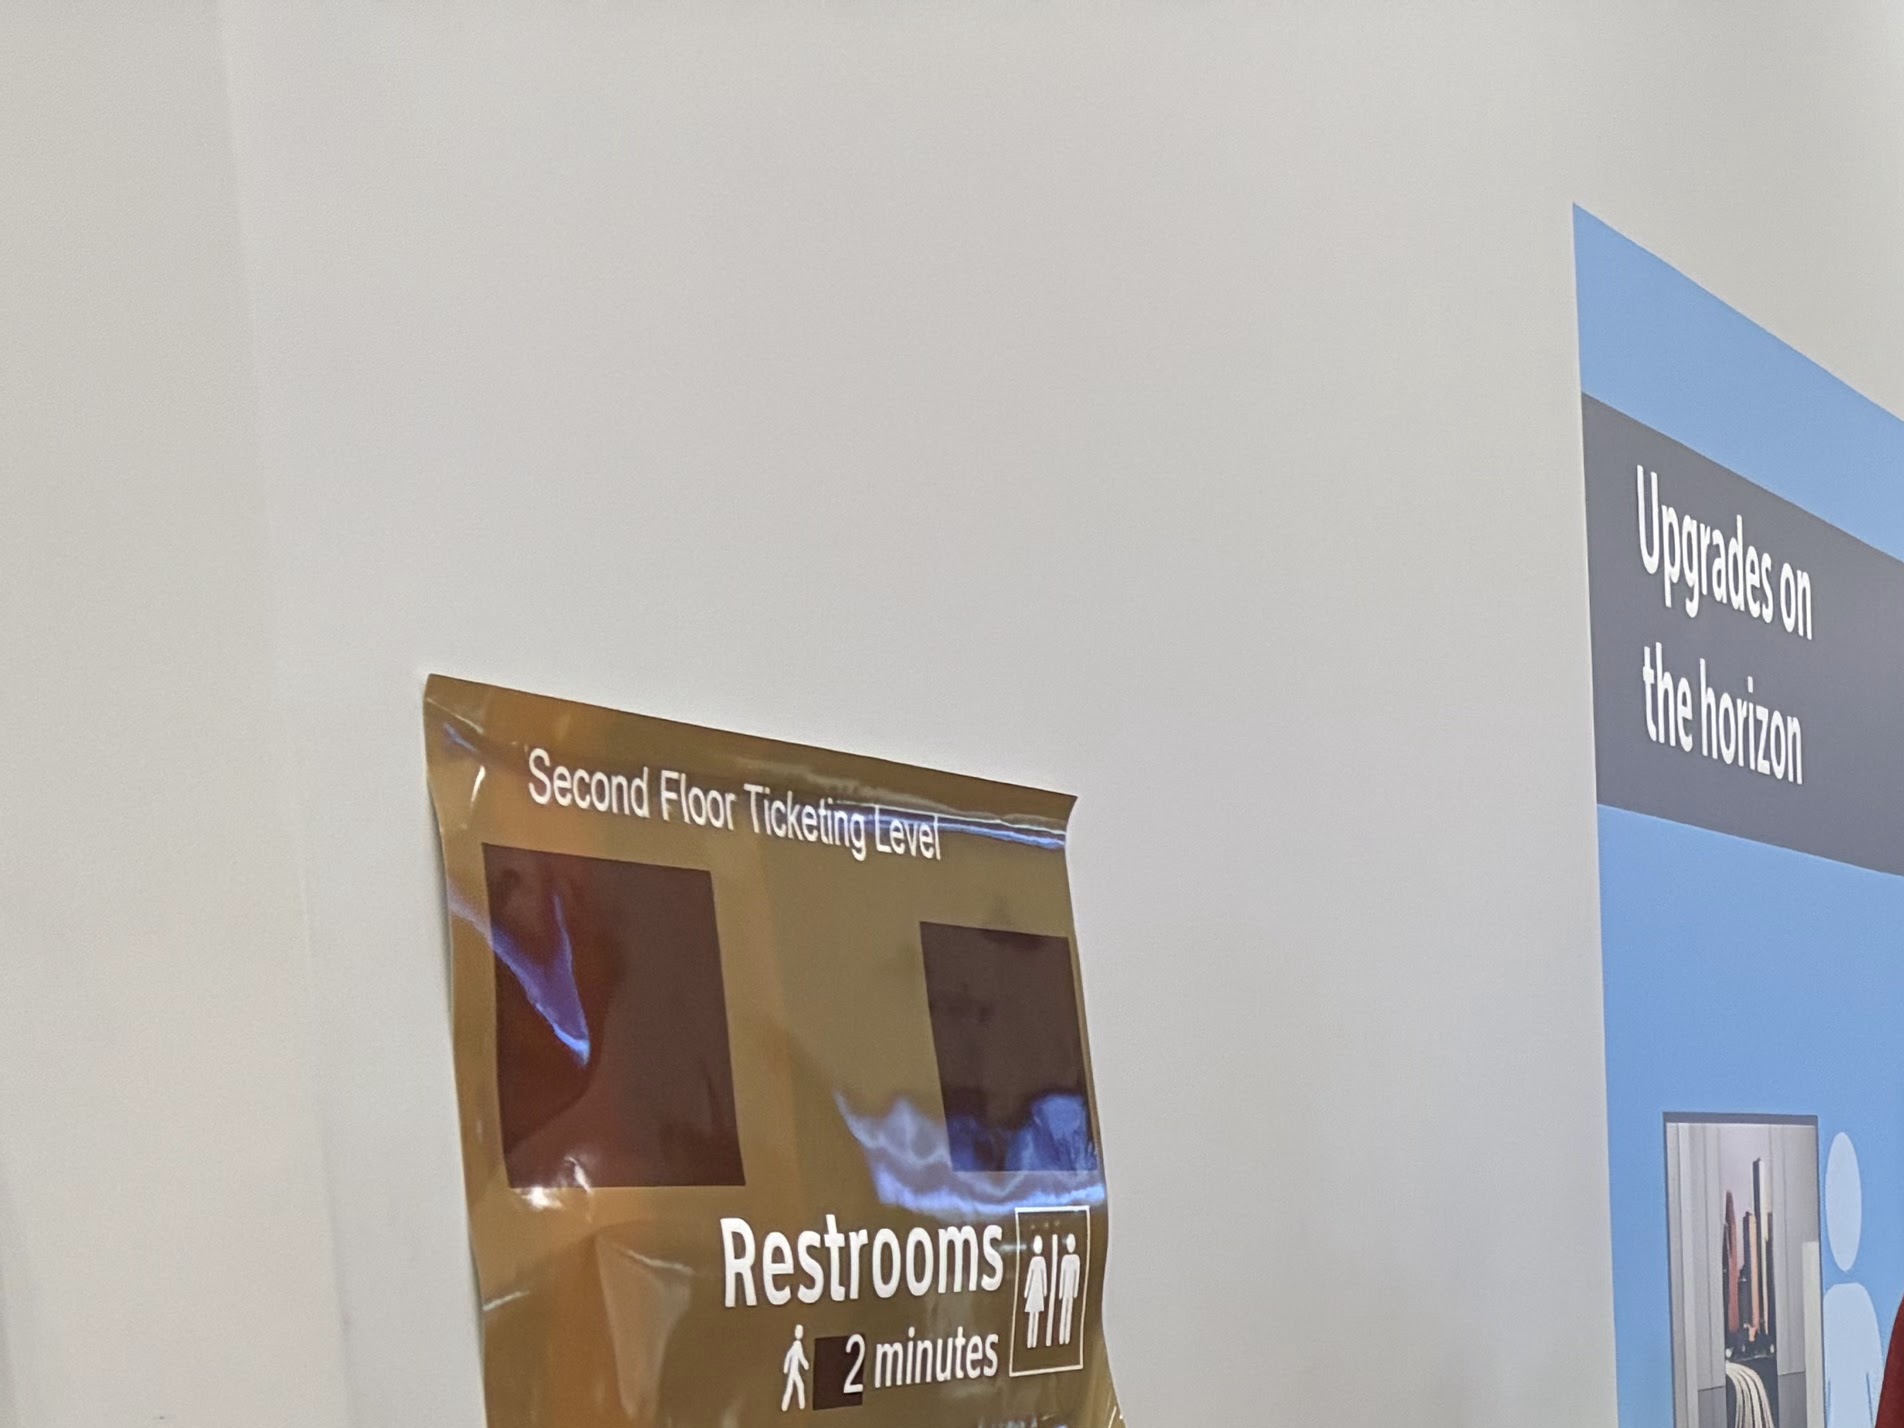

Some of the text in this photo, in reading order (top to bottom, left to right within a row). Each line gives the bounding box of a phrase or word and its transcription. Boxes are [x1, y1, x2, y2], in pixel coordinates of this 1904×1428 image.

[1636, 464, 1812, 641] Upgrades on
[1642, 642, 1803, 785] the horizon
[528, 748, 942, 861] Second Floor Ticketing Level
[722, 1214, 1004, 1308] Restrooms
[844, 1327, 999, 1394] 2 minutes
